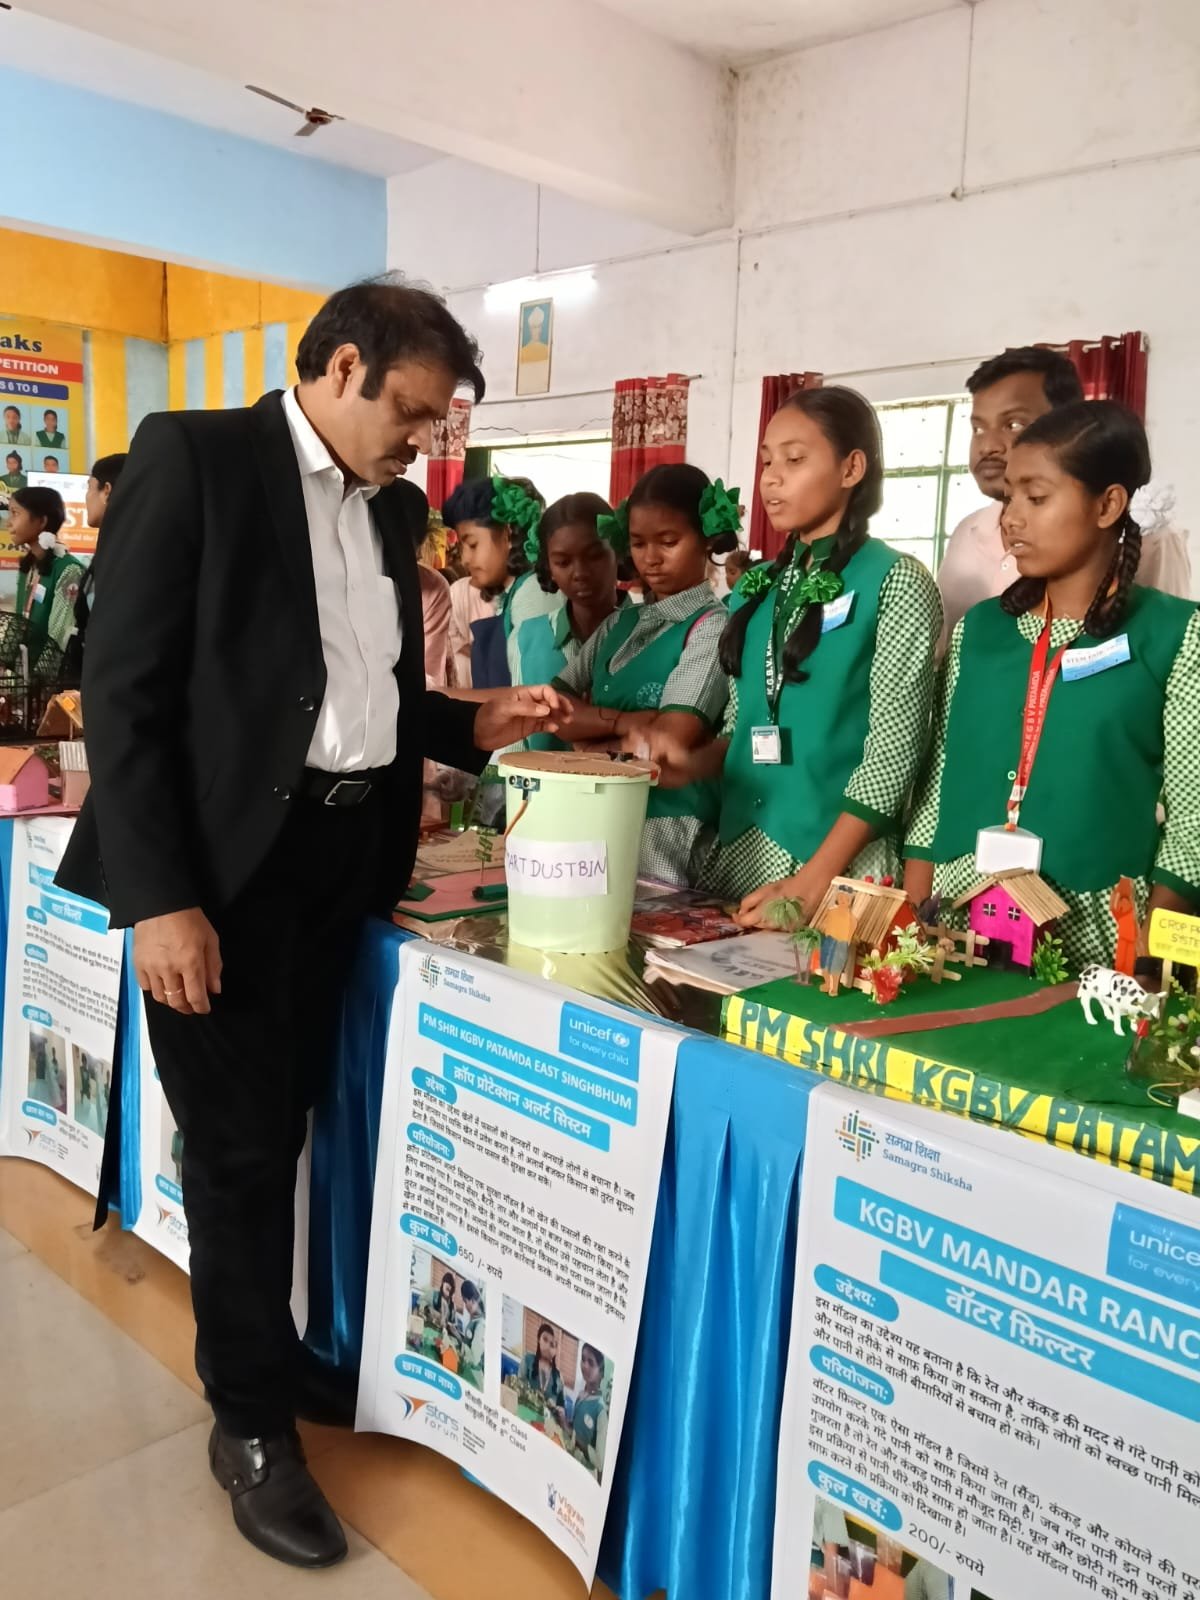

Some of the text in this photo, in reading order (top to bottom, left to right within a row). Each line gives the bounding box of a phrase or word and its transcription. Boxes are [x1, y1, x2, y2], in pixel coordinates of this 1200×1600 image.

[0, 358, 60, 376] ETITION
[16, 382, 30, 392] TO
[530, 856, 606, 880] DUSTBIN
[569, 1018, 613, 1040] unicef
[423, 1012, 631, 1110] PM SHRI KGBV PATAMDA EAST SINGHBHUM
[740, 998, 792, 1058] PM
[800, 1020, 890, 1096] SHRI
[912, 1058, 1040, 1132] KGBV
[453, 1064, 591, 1138] क्रॉप प्रोटेक्शन अलर्ट सिस्टम
[882, 1148, 972, 1191] Samagra Shiksha
[884, 1132, 940, 1163] समग्र शिक्षा
[859, 1197, 934, 1248] KGBV
[941, 1232, 1088, 1315] MANDAR
[835, 1278, 876, 1307] उद्देश्य:
[945, 1286, 1095, 1370] वॉटर फ़िल्टर
[813, 1327, 1040, 1449] और पानी से होने वाली बीमारियों से बचाव हो सके।
[814, 1311, 832, 1326] और
[834, 1321, 854, 1338] सस्ते
[857, 1333, 881, 1352] तरीके
[885, 1344, 894, 1358] से
[923, 1362, 948, 1386] किया
[951, 1379, 966, 1394] जा
[969, 1388, 1002, 1412] सकता
[1020, 1413, 1048, 1434] ताकि
[1052, 1428, 1081, 1450] लोगों
[1084, 1443, 1101, 1459] को
[1105, 1453, 1139, 1477] स्वच्छ
[1144, 1471, 1172, 1493] पानी
[815, 1296, 830, 1309] इस
[832, 1303, 857, 1324] मॉडल
[860, 1318, 873, 1331] का
[905, 1339, 920, 1355] यह
[922, 1348, 952, 1371] बताना
[956, 1361, 963, 1376] है
[966, 1366, 981, 1384] कि
[984, 1374, 999, 1393] रेत
[1002, 1386, 1024, 1405] और
[1062, 1413, 1079, 1430] की
[1082, 1423, 1109, 1445] मदद
[1113, 1435, 1124, 1451] से
[1128, 1444, 1146, 1462] गंदे
[1150, 1454, 1178, 1477] पानी
[821, 1355, 888, 1400] परियोजना:
[426, 1404, 460, 1432] stars
[812, 1378, 834, 1395] वॉटर
[870, 1407, 886, 1423] एक
[890, 1416, 909, 1437] ऐसा
[913, 1431, 941, 1454] मॉडल
[945, 1446, 953, 1460] है
[957, 1452, 988, 1480] जिसमें
[993, 1471, 1007, 1489] रेत
[1048, 1502, 1081, 1528] कंकड़
[1086, 1523, 1109, 1542] और
[1114, 1536, 1152, 1564] कोयले
[1158, 1558, 1176, 1577] की
[812, 1393, 842, 1415] उपयोग
[846, 1411, 869, 1432] करके
[873, 1425, 886, 1440] गंदे
[890, 1435, 911, 1454] पानी
[915, 1449, 929, 1464] को
[960, 1471, 985, 1495] किया
[990, 1491, 1017, 1511] जाता
[1022, 1503, 1034, 1521] है।
[1040, 1516, 1059, 1534] जब
[1065, 1529, 1086, 1547] गंदा
[1091, 1543, 1117, 1565] पानी
[1122, 1559, 1140, 1576] इन
[1146, 1572, 1176, 1596] परतों
[817, 1469, 887, 1519] कुल खर्च:
[908, 1522, 984, 1576] 200/- रुपये
